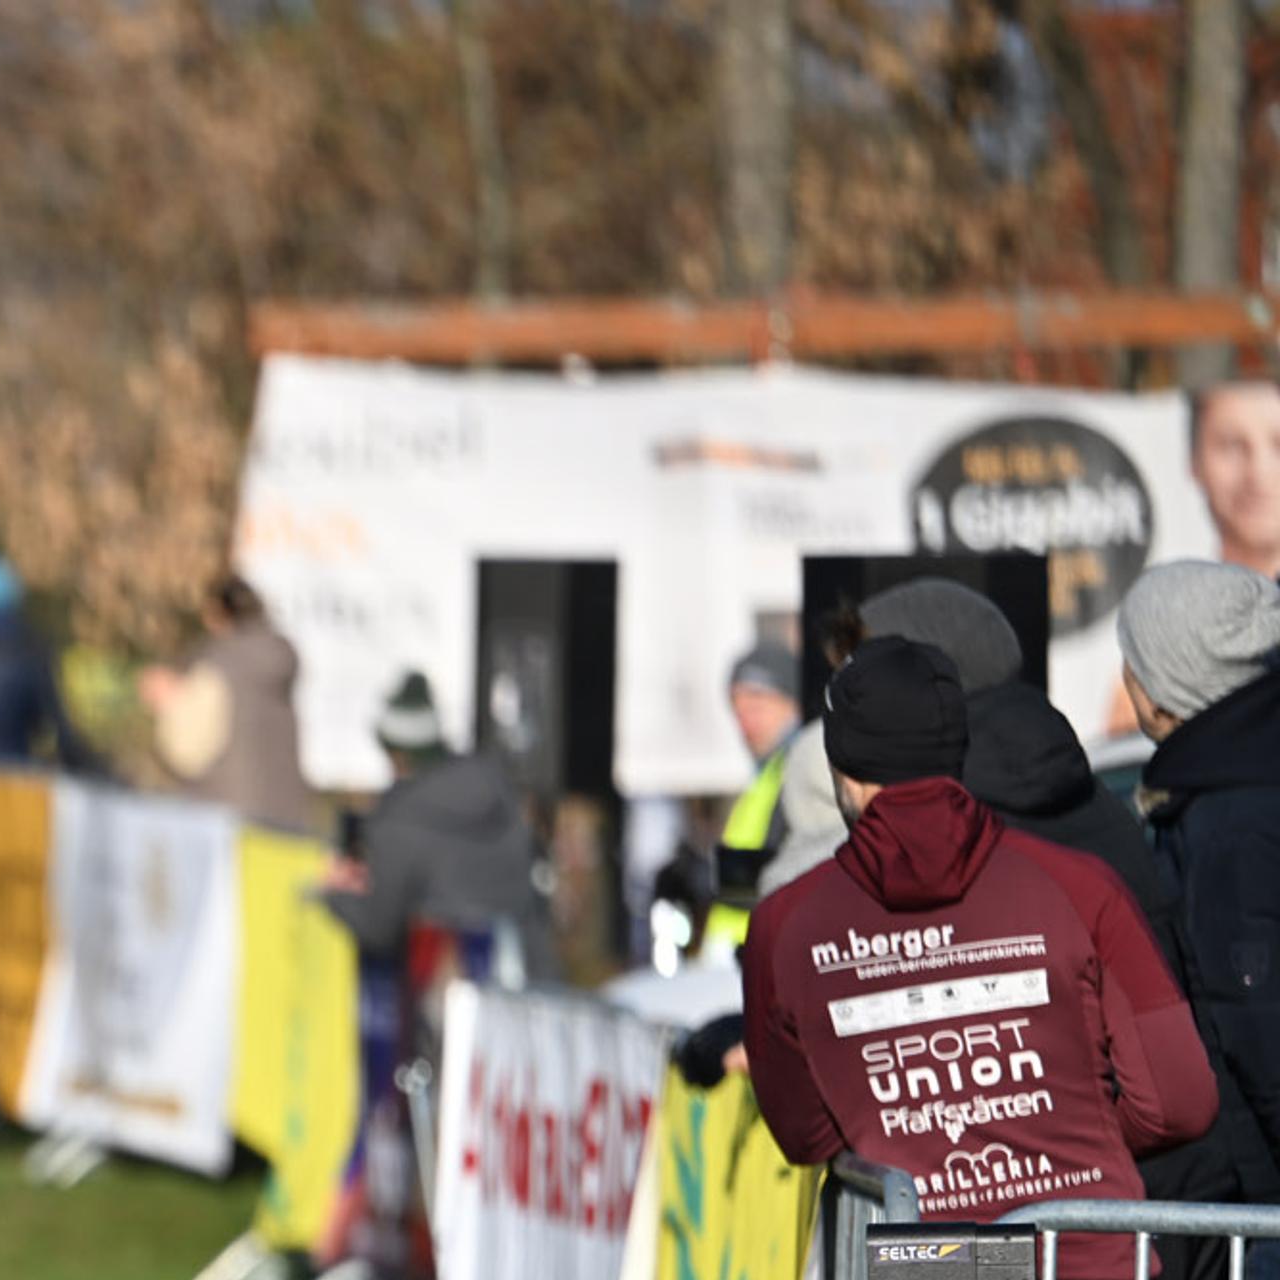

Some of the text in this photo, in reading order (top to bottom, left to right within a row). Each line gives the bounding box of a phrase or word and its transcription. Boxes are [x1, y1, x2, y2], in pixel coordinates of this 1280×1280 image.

[811, 924, 954, 967] m.berger
[861, 1018, 1030, 1075] SPORT
[868, 1050, 1045, 1103] union
[880, 1089, 1054, 1137] Pfaffstätten
[913, 1153, 1053, 1196] BRILLERIA
[879, 1244, 938, 1261] SELTEC
